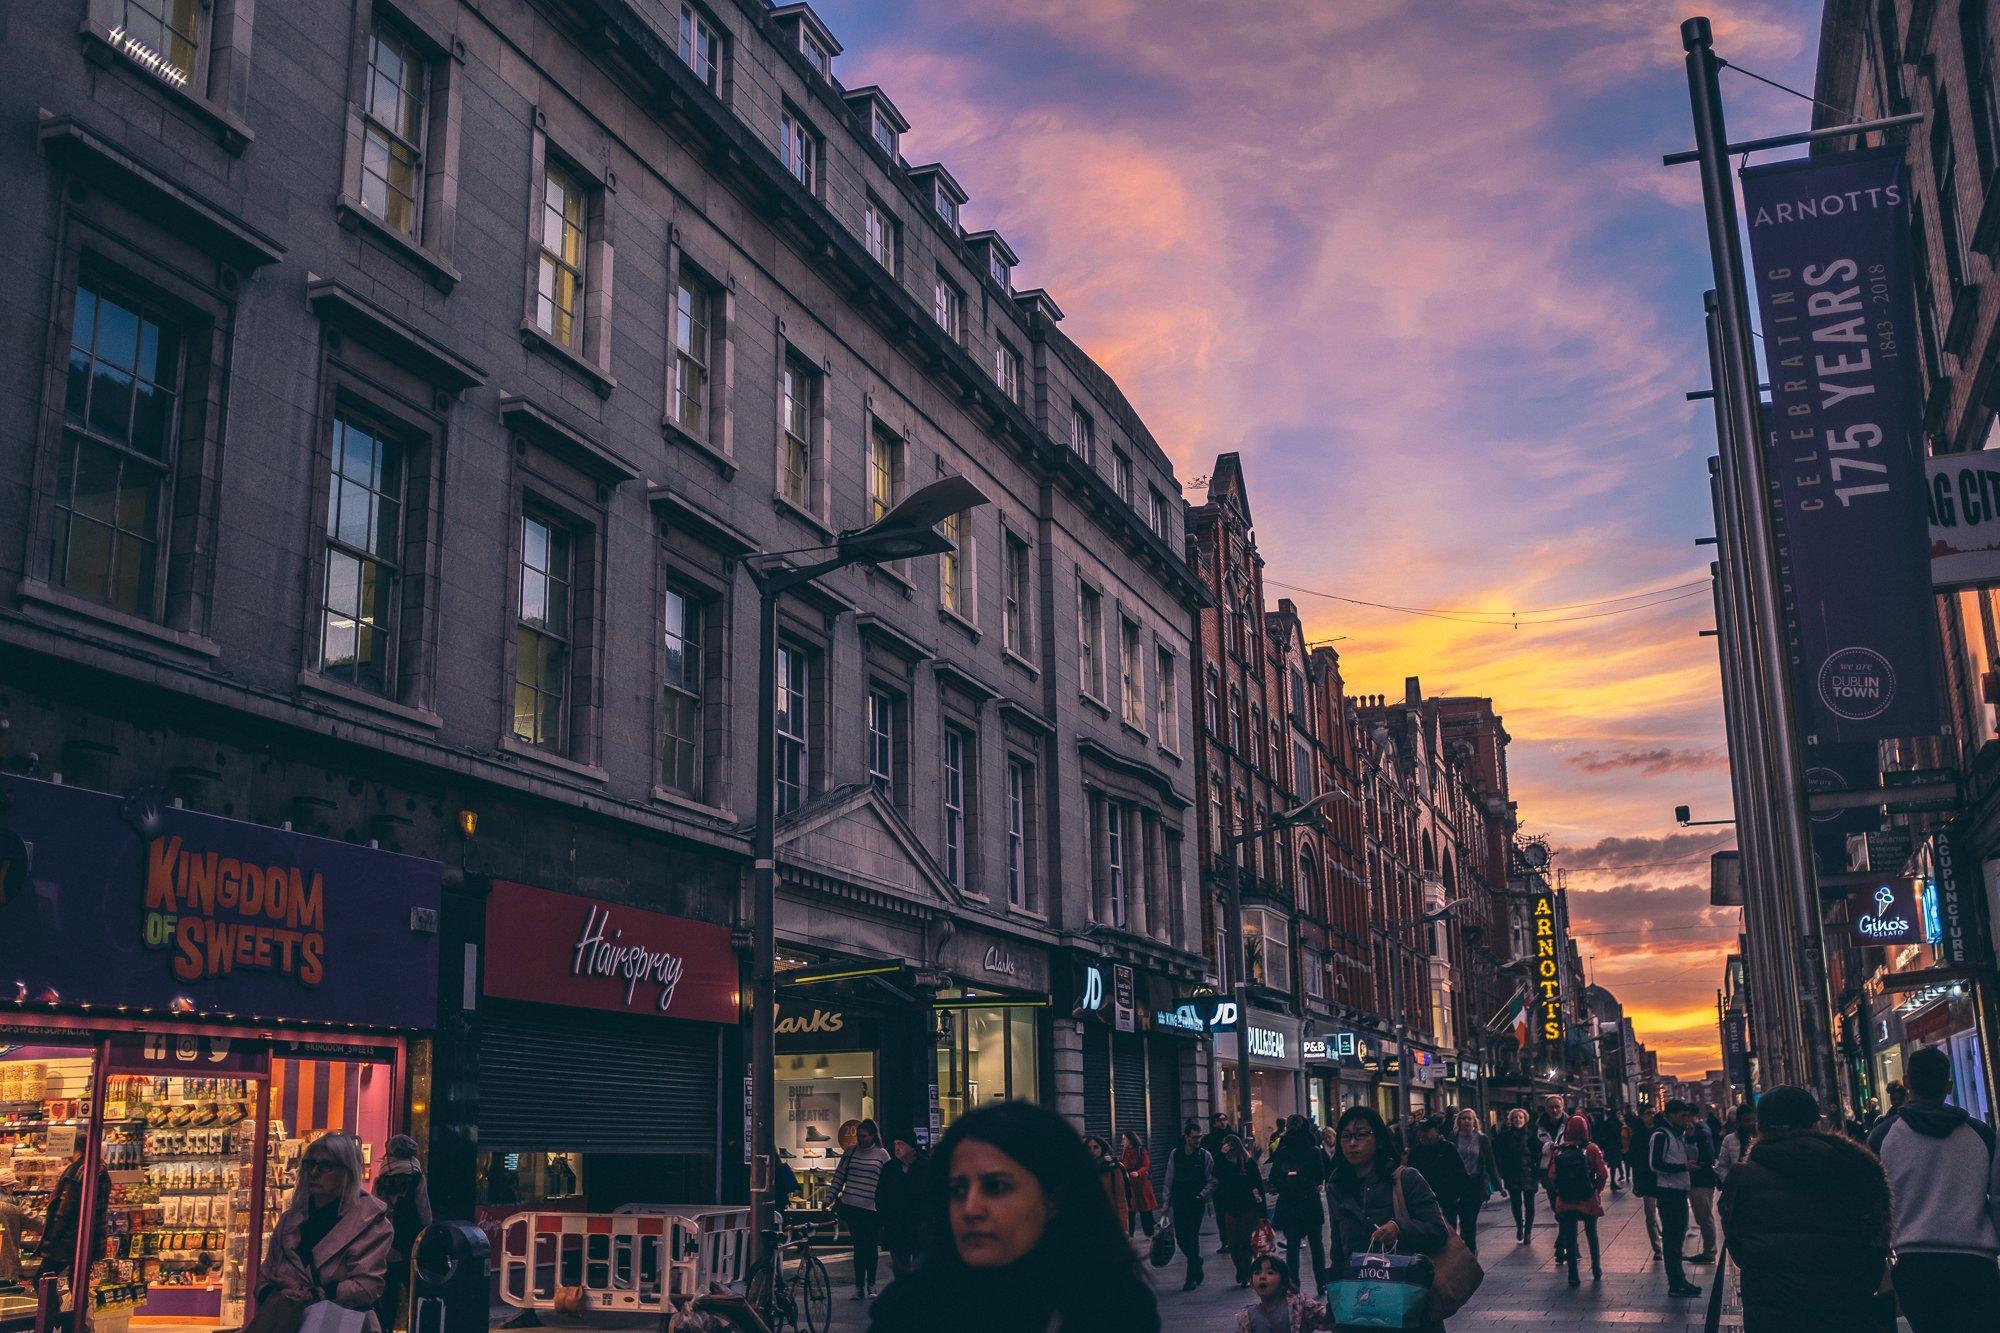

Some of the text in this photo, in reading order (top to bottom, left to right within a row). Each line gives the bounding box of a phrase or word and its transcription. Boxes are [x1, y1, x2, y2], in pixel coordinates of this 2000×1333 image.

[1754, 185, 1900, 227] ARNOTTS
[1868, 263, 1890, 303] 2018
[1877, 320, 1898, 359] 1843
[1768, 267, 1825, 511] CELEBRATING
[1803, 258, 1890, 507] 175 YEARS
[1832, 675, 1879, 687] DUBLIN
[1840, 663, 1873, 671] we are
[1832, 687, 1879, 698] TOWN
[146, 835, 325, 931] KINGDOM
[1938, 833, 1965, 962] ACUPUNCTURE
[1859, 914, 1909, 935] Gino's
[1873, 929, 1904, 938] GELATO
[146, 912, 325, 986] OF SWEETS
[576, 904, 684, 1012] Hairspray
[984, 945, 1015, 974] Clarks
[1534, 897, 1560, 1040] ARNOTTS
[1083, 966, 1102, 1010] JD
[774, 1003, 844, 1033] larks
[1210, 1003, 1237, 1025] JD
[1248, 1026, 1286, 1058] PULL&BEAR
[1303, 1041, 1325, 1052] P&B
[788, 1085, 814, 1098] BUILT
[788, 1109, 830, 1121] BREATHE
[1358, 1268, 1391, 1280] AVOCA
